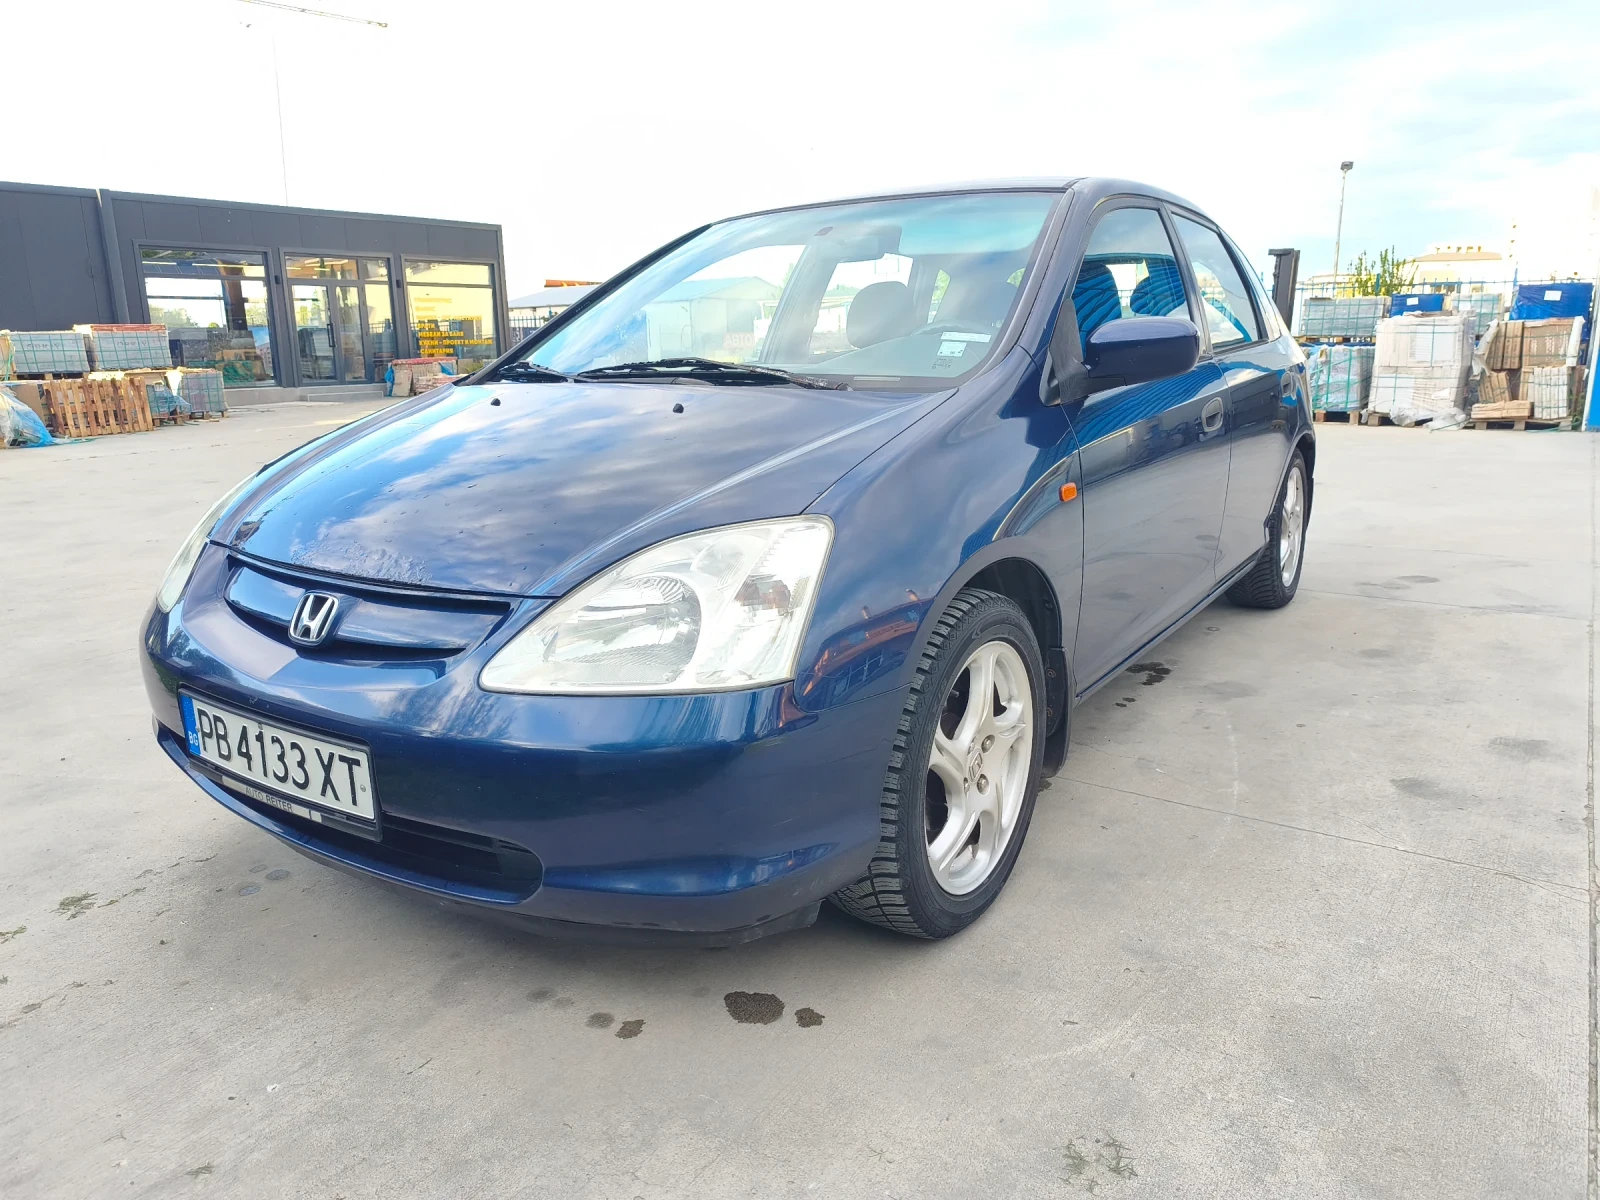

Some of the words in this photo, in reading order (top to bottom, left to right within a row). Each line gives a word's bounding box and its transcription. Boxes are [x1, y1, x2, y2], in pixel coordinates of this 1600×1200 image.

[188, 731, 199, 747] BG
[245, 787, 264, 801] AUTO
[265, 794, 293, 812] REITER
